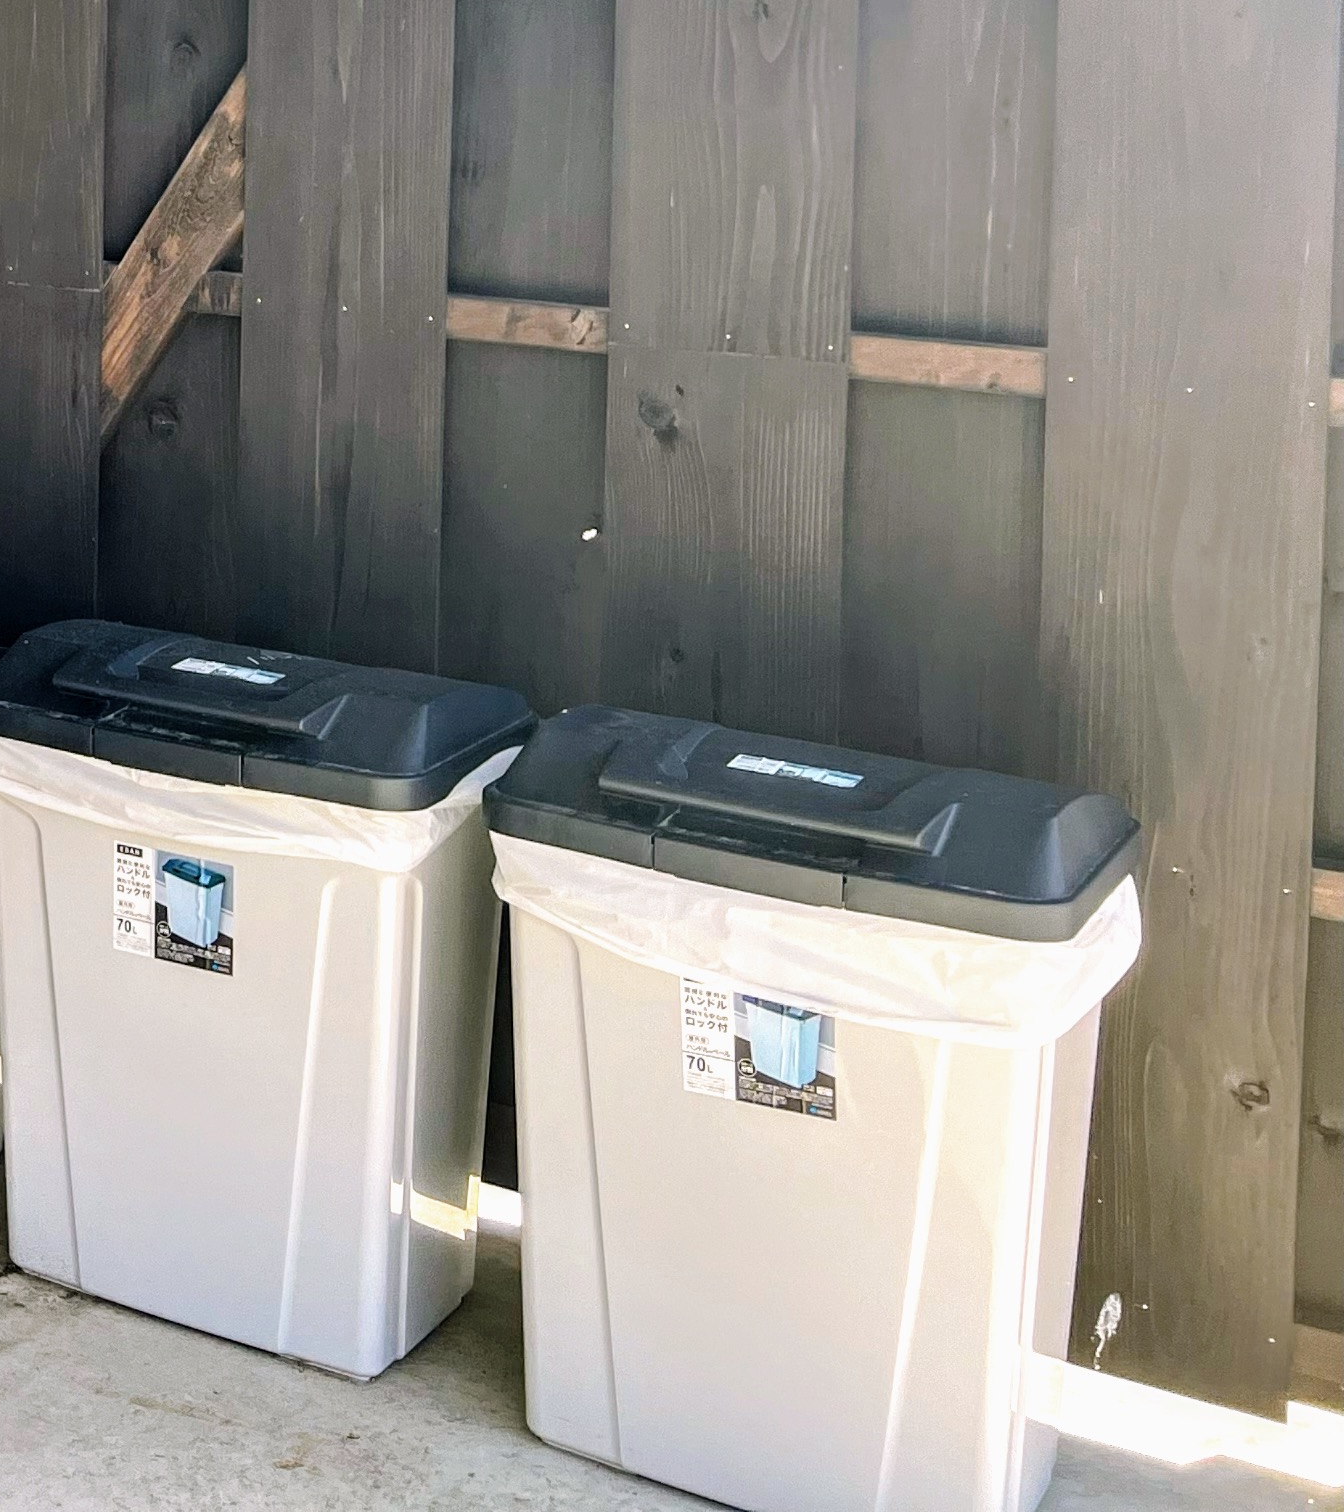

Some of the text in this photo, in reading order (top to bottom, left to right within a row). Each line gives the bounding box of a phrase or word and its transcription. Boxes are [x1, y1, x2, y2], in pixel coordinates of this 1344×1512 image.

[116, 865, 151, 879] ハンドル
[116, 884, 151, 900] ロック付
[684, 994, 728, 1011] ハンドル
[685, 1016, 729, 1034] ロック付
